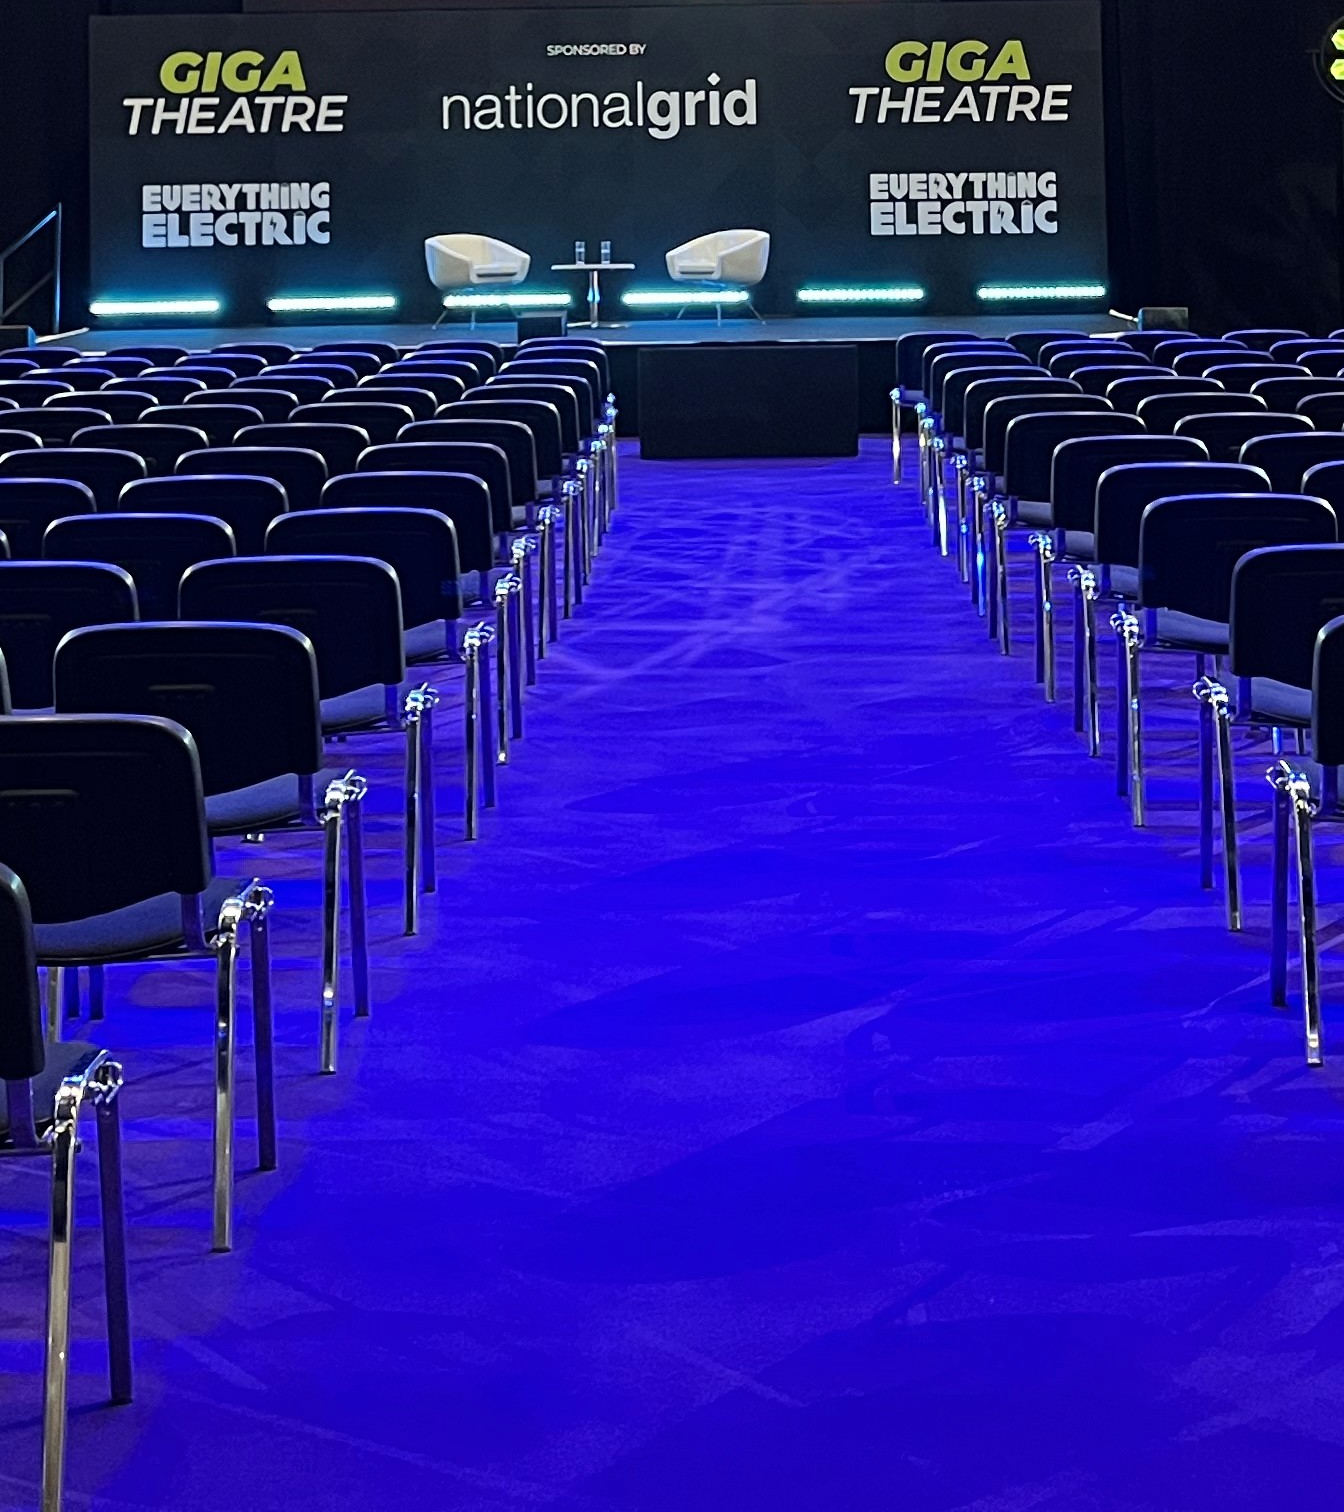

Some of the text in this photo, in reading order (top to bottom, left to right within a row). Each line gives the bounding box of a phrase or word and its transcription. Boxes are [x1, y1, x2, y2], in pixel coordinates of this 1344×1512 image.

[546, 43, 647, 56] SPONSORED BY
[885, 40, 1031, 83] GIGA
[160, 50, 306, 94] GIGA
[123, 95, 348, 135] THEATRE
[442, 72, 757, 139] nationalgrid
[849, 84, 1073, 124] THEATRE
[142, 182, 330, 211] EVERYTHING
[869, 171, 1057, 200] EVERYTHING
[142, 211, 330, 248] ELECTRIC
[870, 200, 1058, 235] ELECTRIC
